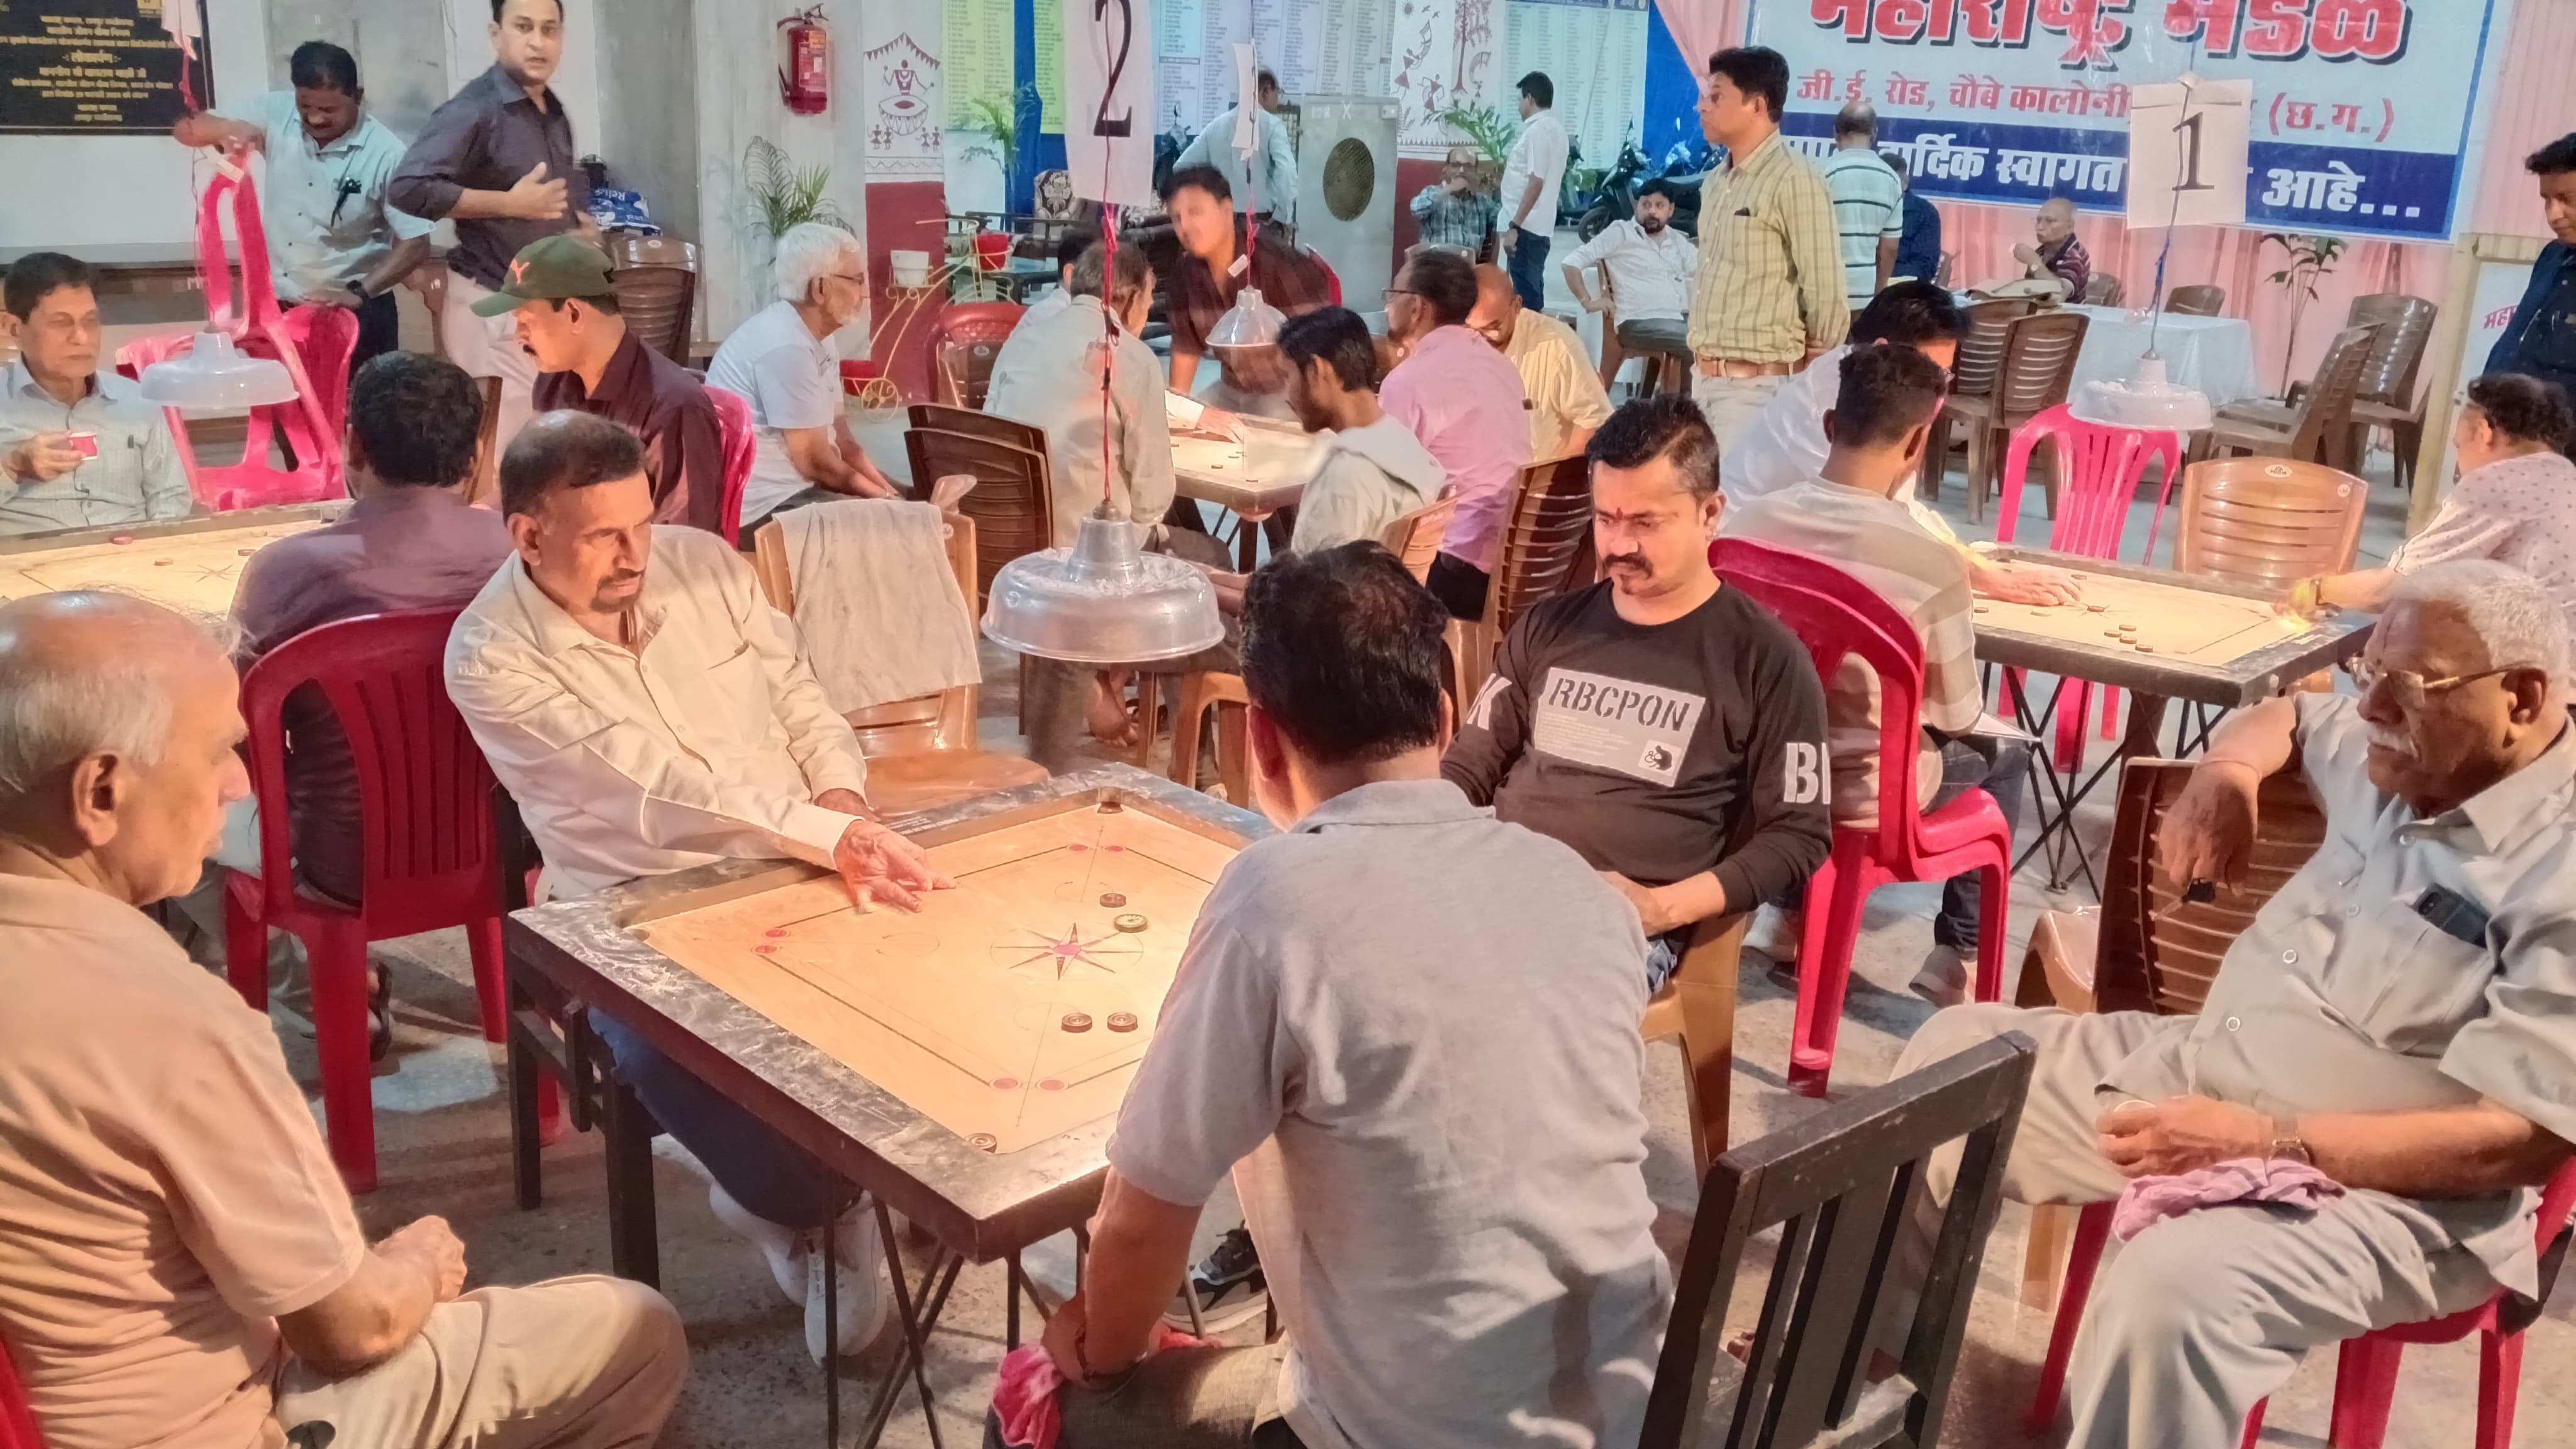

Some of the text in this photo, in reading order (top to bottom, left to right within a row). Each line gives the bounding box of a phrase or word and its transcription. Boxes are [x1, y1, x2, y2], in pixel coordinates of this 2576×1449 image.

[2164, 0, 2411, 65] मडळ
[1094, 0, 1131, 137] 2
[1885, 70, 1935, 113] रोड,
[1950, 74, 2004, 110] चौबे
[2268, 92, 2394, 143] (छ.ग.)
[1996, 148, 2128, 192] स्वागत
[2262, 160, 2421, 218] आहे...
[2172, 111, 2214, 191] 1
[1548, 677, 1690, 732] RBCPON
